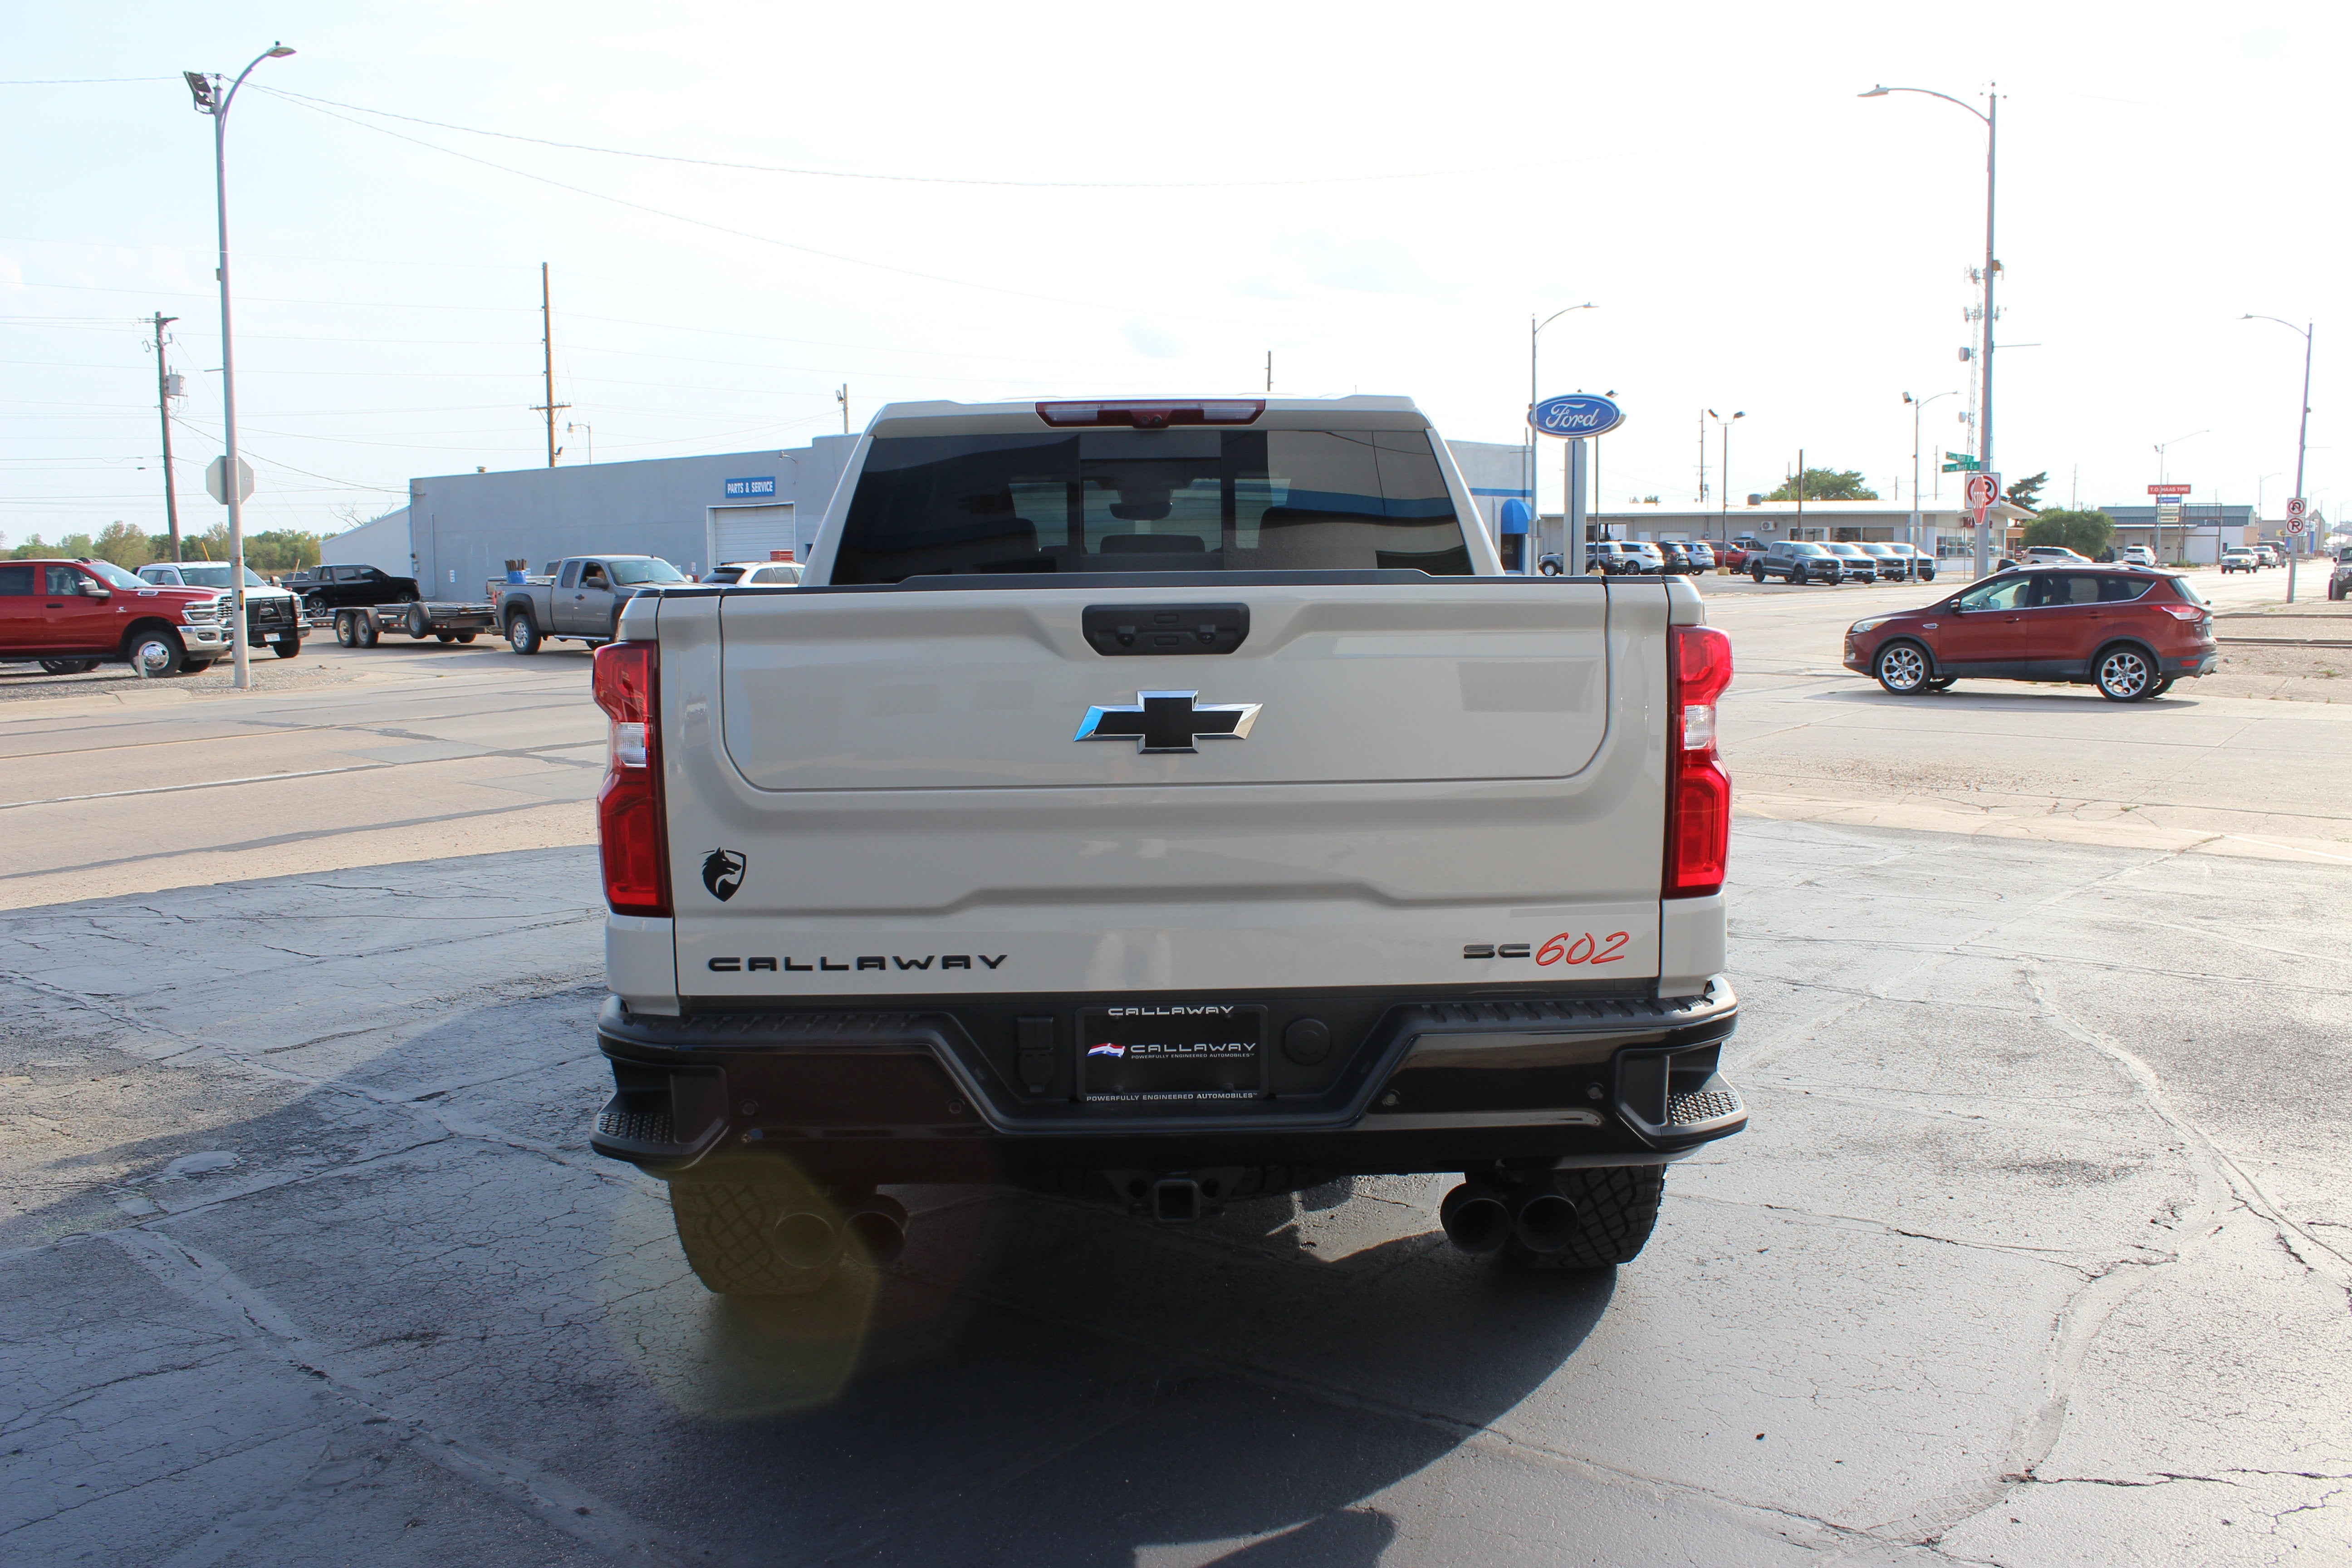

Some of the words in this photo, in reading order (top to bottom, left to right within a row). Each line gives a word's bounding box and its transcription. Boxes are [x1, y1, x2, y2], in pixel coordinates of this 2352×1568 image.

[1546, 403, 1600, 428] Ford
[727, 482, 744, 494] PARTS
[745, 482, 750, 493] &
[751, 481, 773, 493] SERVICE
[1973, 491, 1985, 509] STOP
[1464, 943, 1530, 959] SC
[1536, 931, 1630, 966] 602
[708, 954, 1008, 972] CALLAWAY
[1108, 1006, 1234, 1016] CALLAWAY
[1130, 1043, 1256, 1053] CALLAWAY
